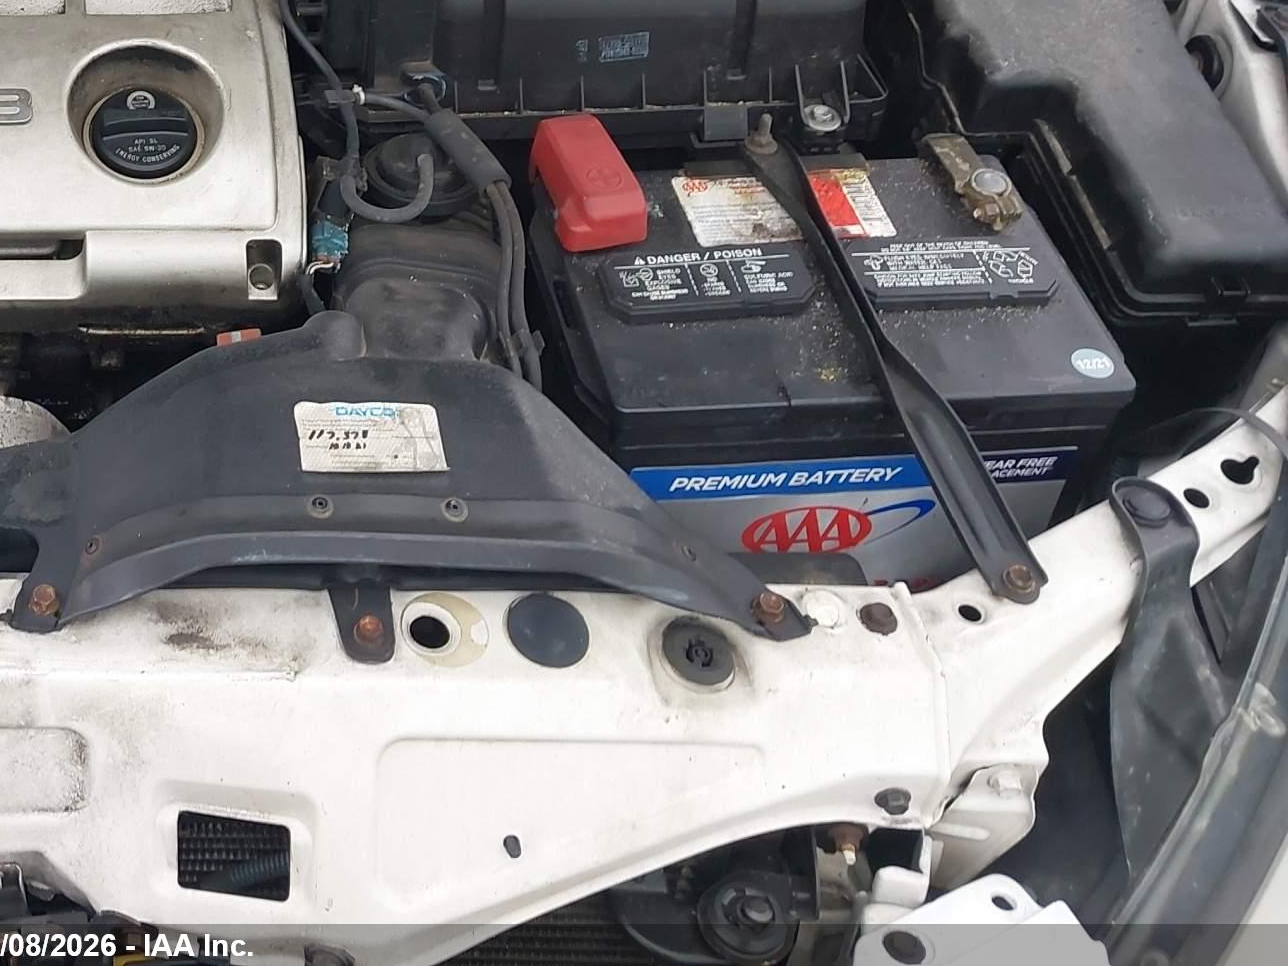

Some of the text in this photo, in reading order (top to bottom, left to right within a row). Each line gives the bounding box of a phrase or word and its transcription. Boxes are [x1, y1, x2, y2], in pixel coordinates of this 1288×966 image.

[645, 247, 763, 265] DANGER / POISON
[1076, 356, 1111, 371] 12/21
[983, 456, 1059, 471] EAR FREE
[669, 466, 903, 493] PREMIUM BATTERY
[991, 466, 1054, 480] ACEMENT
[748, 506, 867, 553] AAA
